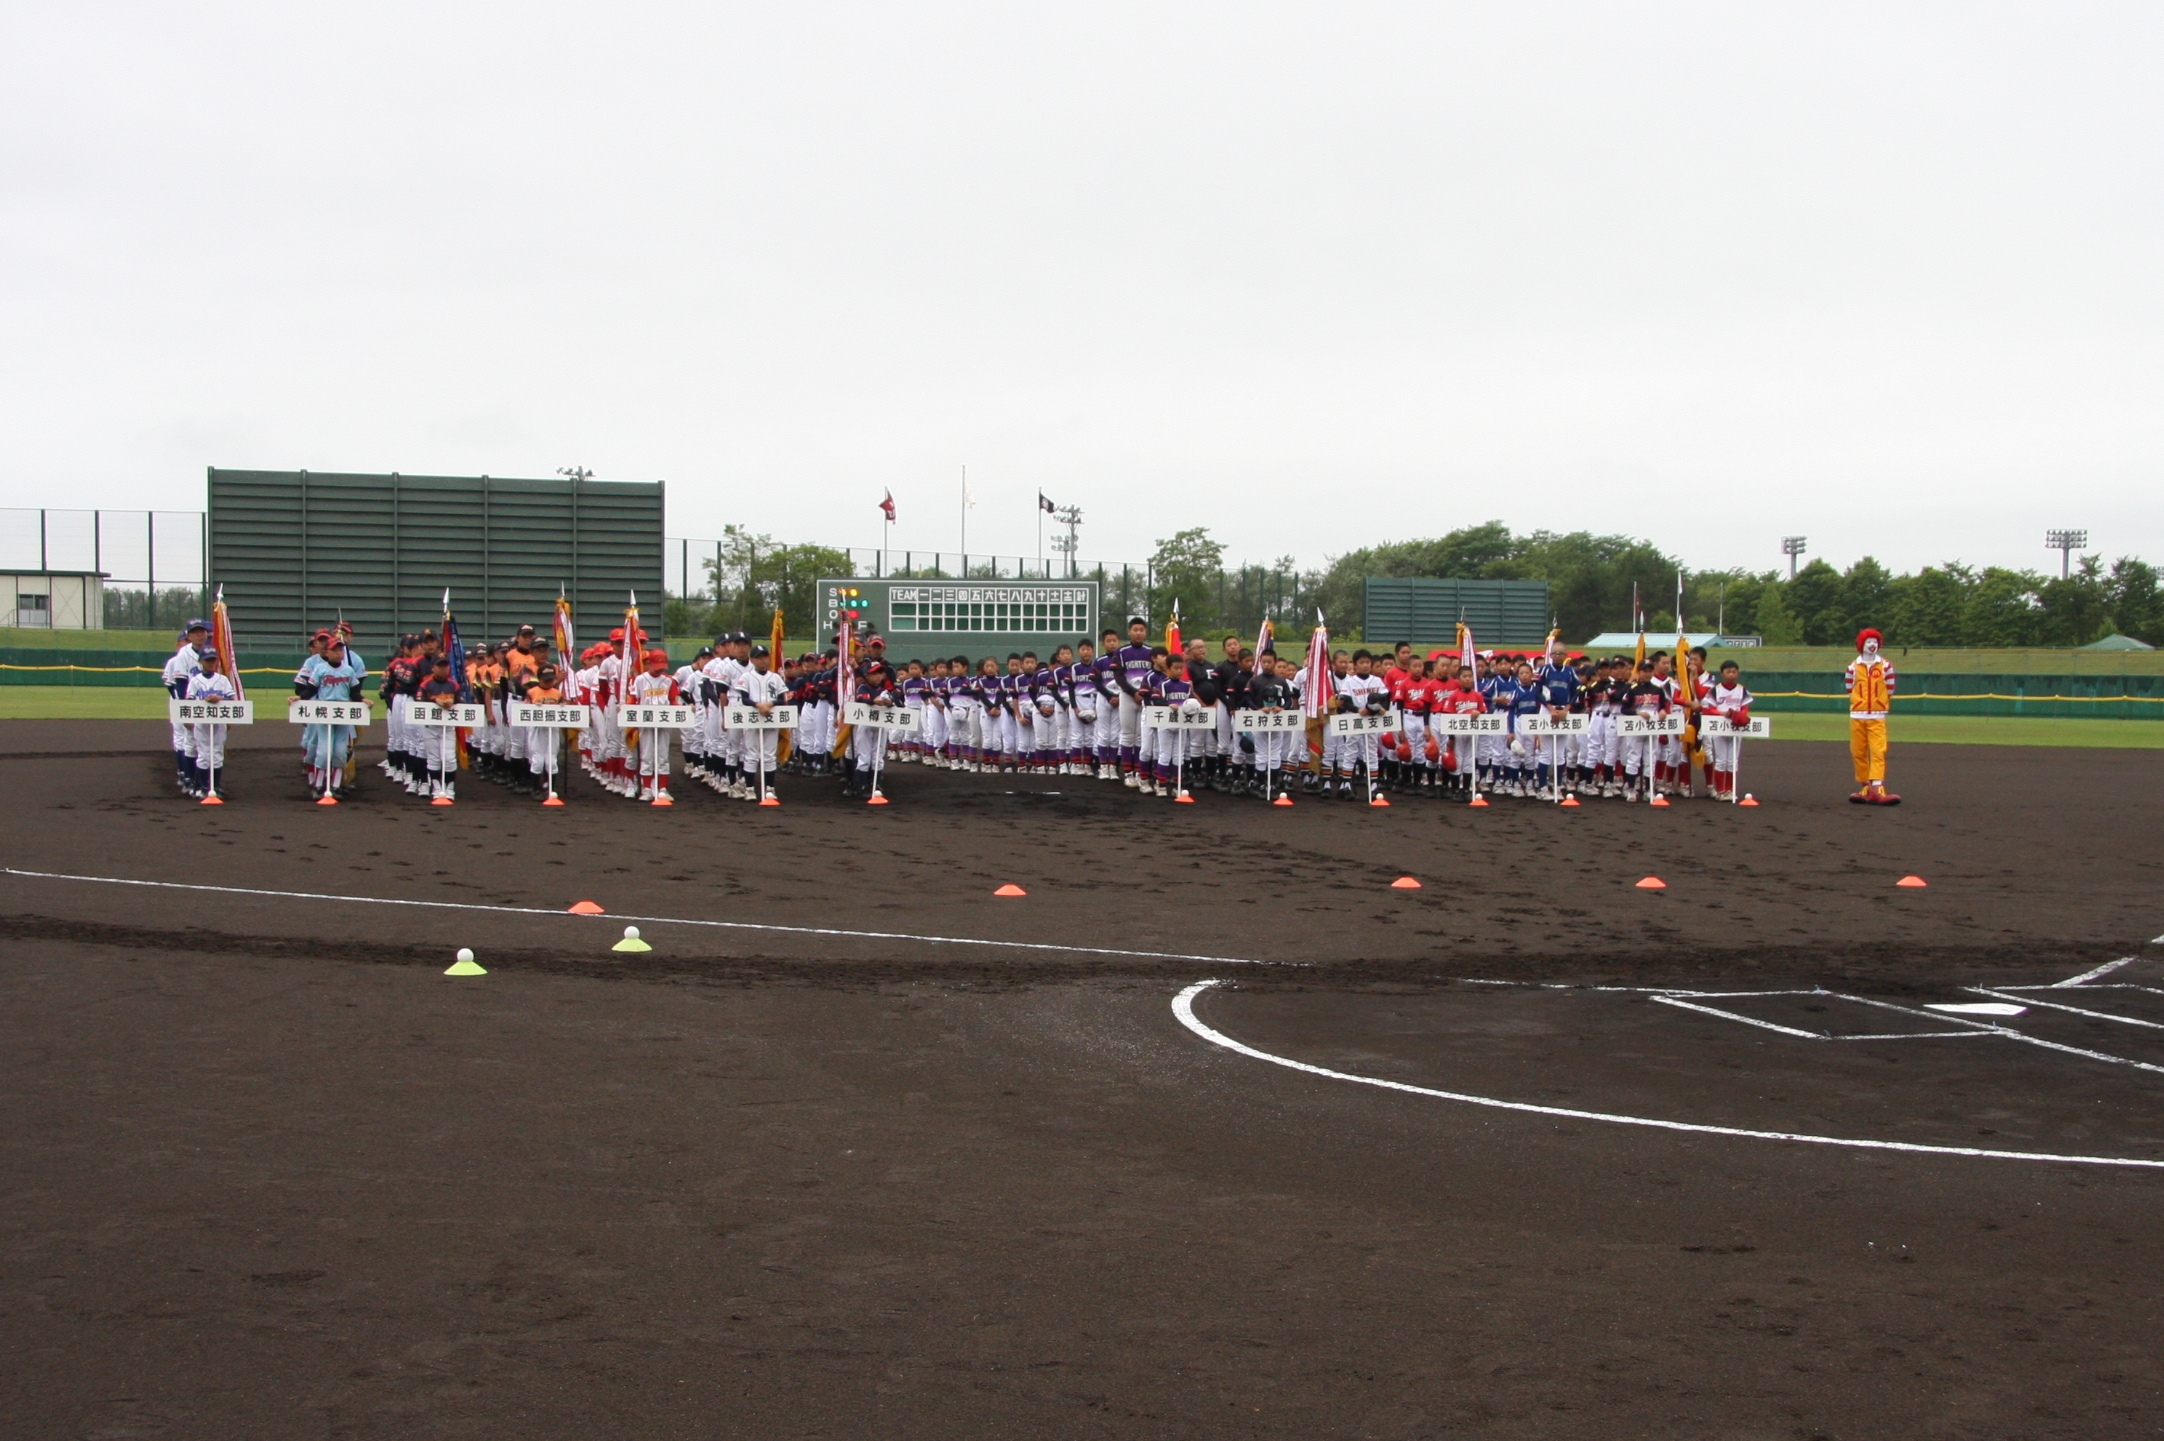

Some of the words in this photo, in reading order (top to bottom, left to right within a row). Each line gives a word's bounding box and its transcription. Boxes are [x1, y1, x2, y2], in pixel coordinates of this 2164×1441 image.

[829, 587, 838, 597] S
[891, 589, 917, 600] TEAM
[828, 598, 838, 608] B
[829, 609, 838, 619] O
[823, 620, 833, 630] H
[857, 620, 868, 630] F
[179, 705, 244, 719] 南空知支部
[298, 705, 362, 720] 札幌支部
[414, 707, 476, 721] 函館支部
[520, 709, 581, 723] 西胆振支部
[626, 709, 686, 723] 室蘭支部
[853, 708, 911, 725] 小樽支部
[1243, 714, 1298, 727] 石狩支部
[1338, 715, 1394, 731] 日高支部
[1448, 719, 1501, 731] 北空知支部
[1624, 718, 1678, 732] 苫小牧支部
